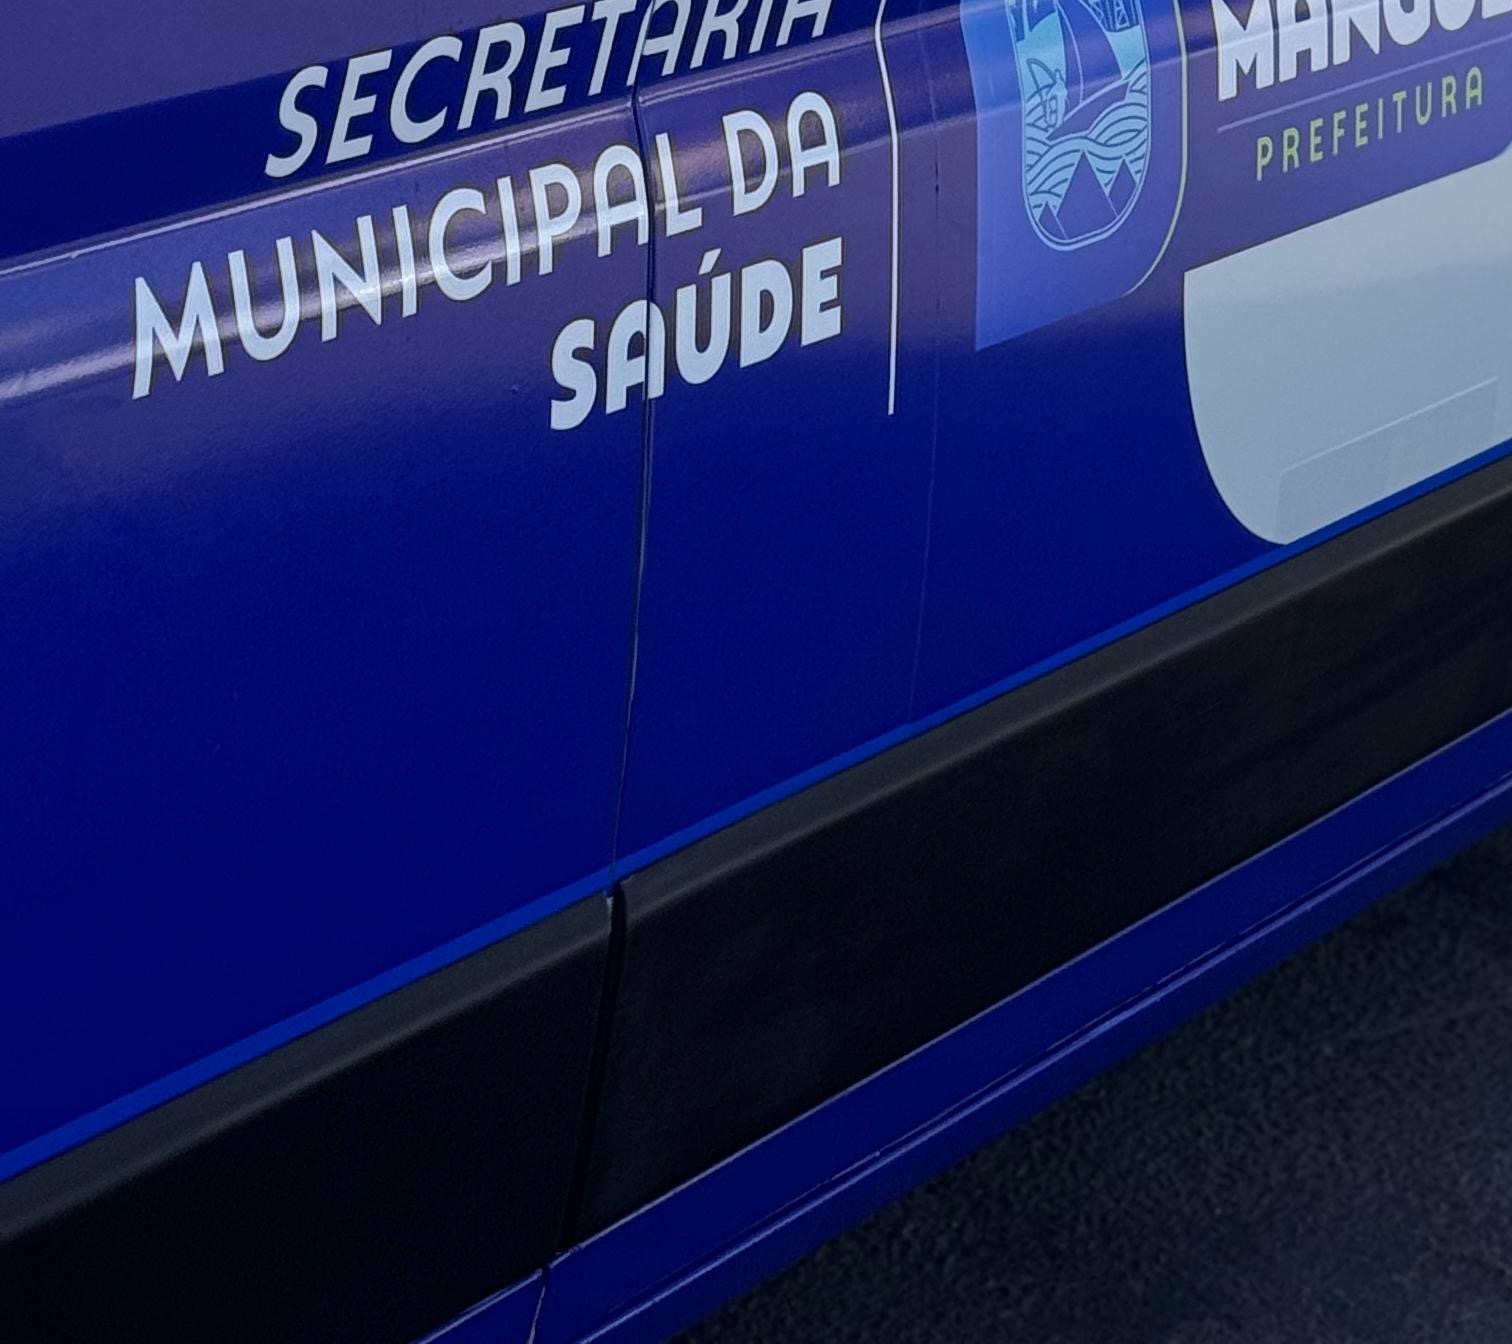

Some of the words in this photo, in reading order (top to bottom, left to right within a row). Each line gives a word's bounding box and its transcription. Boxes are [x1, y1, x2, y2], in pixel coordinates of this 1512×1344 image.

[1256, 67, 1483, 181] PREFEITURA
[132, 132, 703, 399] MUNICIPAL
[723, 92, 842, 216] DA
[551, 238, 843, 430] SAÚDE
